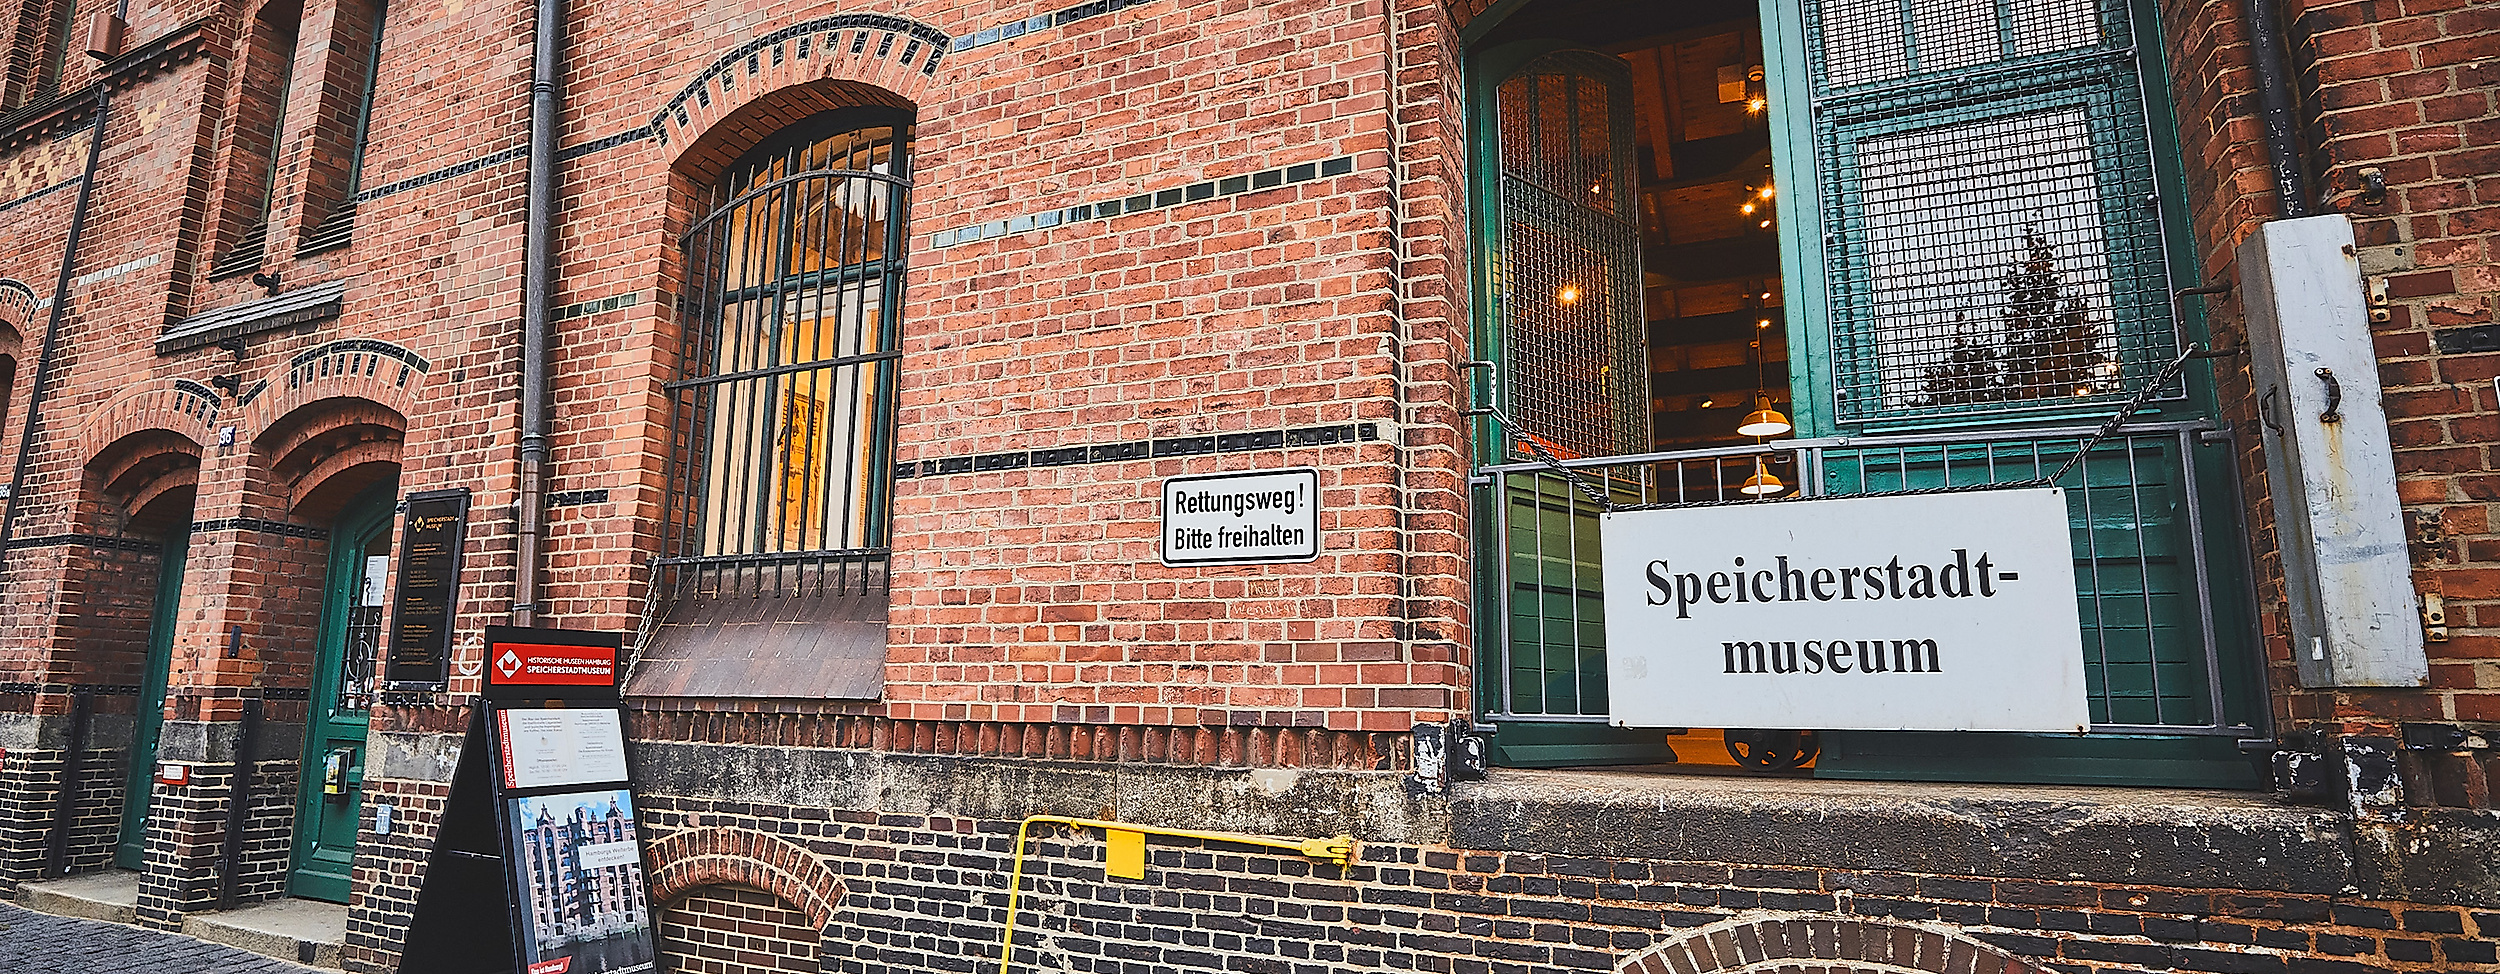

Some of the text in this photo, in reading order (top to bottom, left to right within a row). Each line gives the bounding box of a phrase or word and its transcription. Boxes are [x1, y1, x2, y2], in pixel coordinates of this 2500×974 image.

[1175, 482, 1304, 517] Rettungsweg!
[1175, 523, 1304, 550] Bitte freihalten
[1645, 548, 2020, 620] Speicherstadt-
[527, 656, 612, 666] HISTORISCHE MUSEEN HAMBURG
[527, 665, 611, 675] SPEICHERSTADTMUSEUM
[1721, 636, 1943, 675] museum
[500, 710, 515, 787] Speicherstadtmuseum
